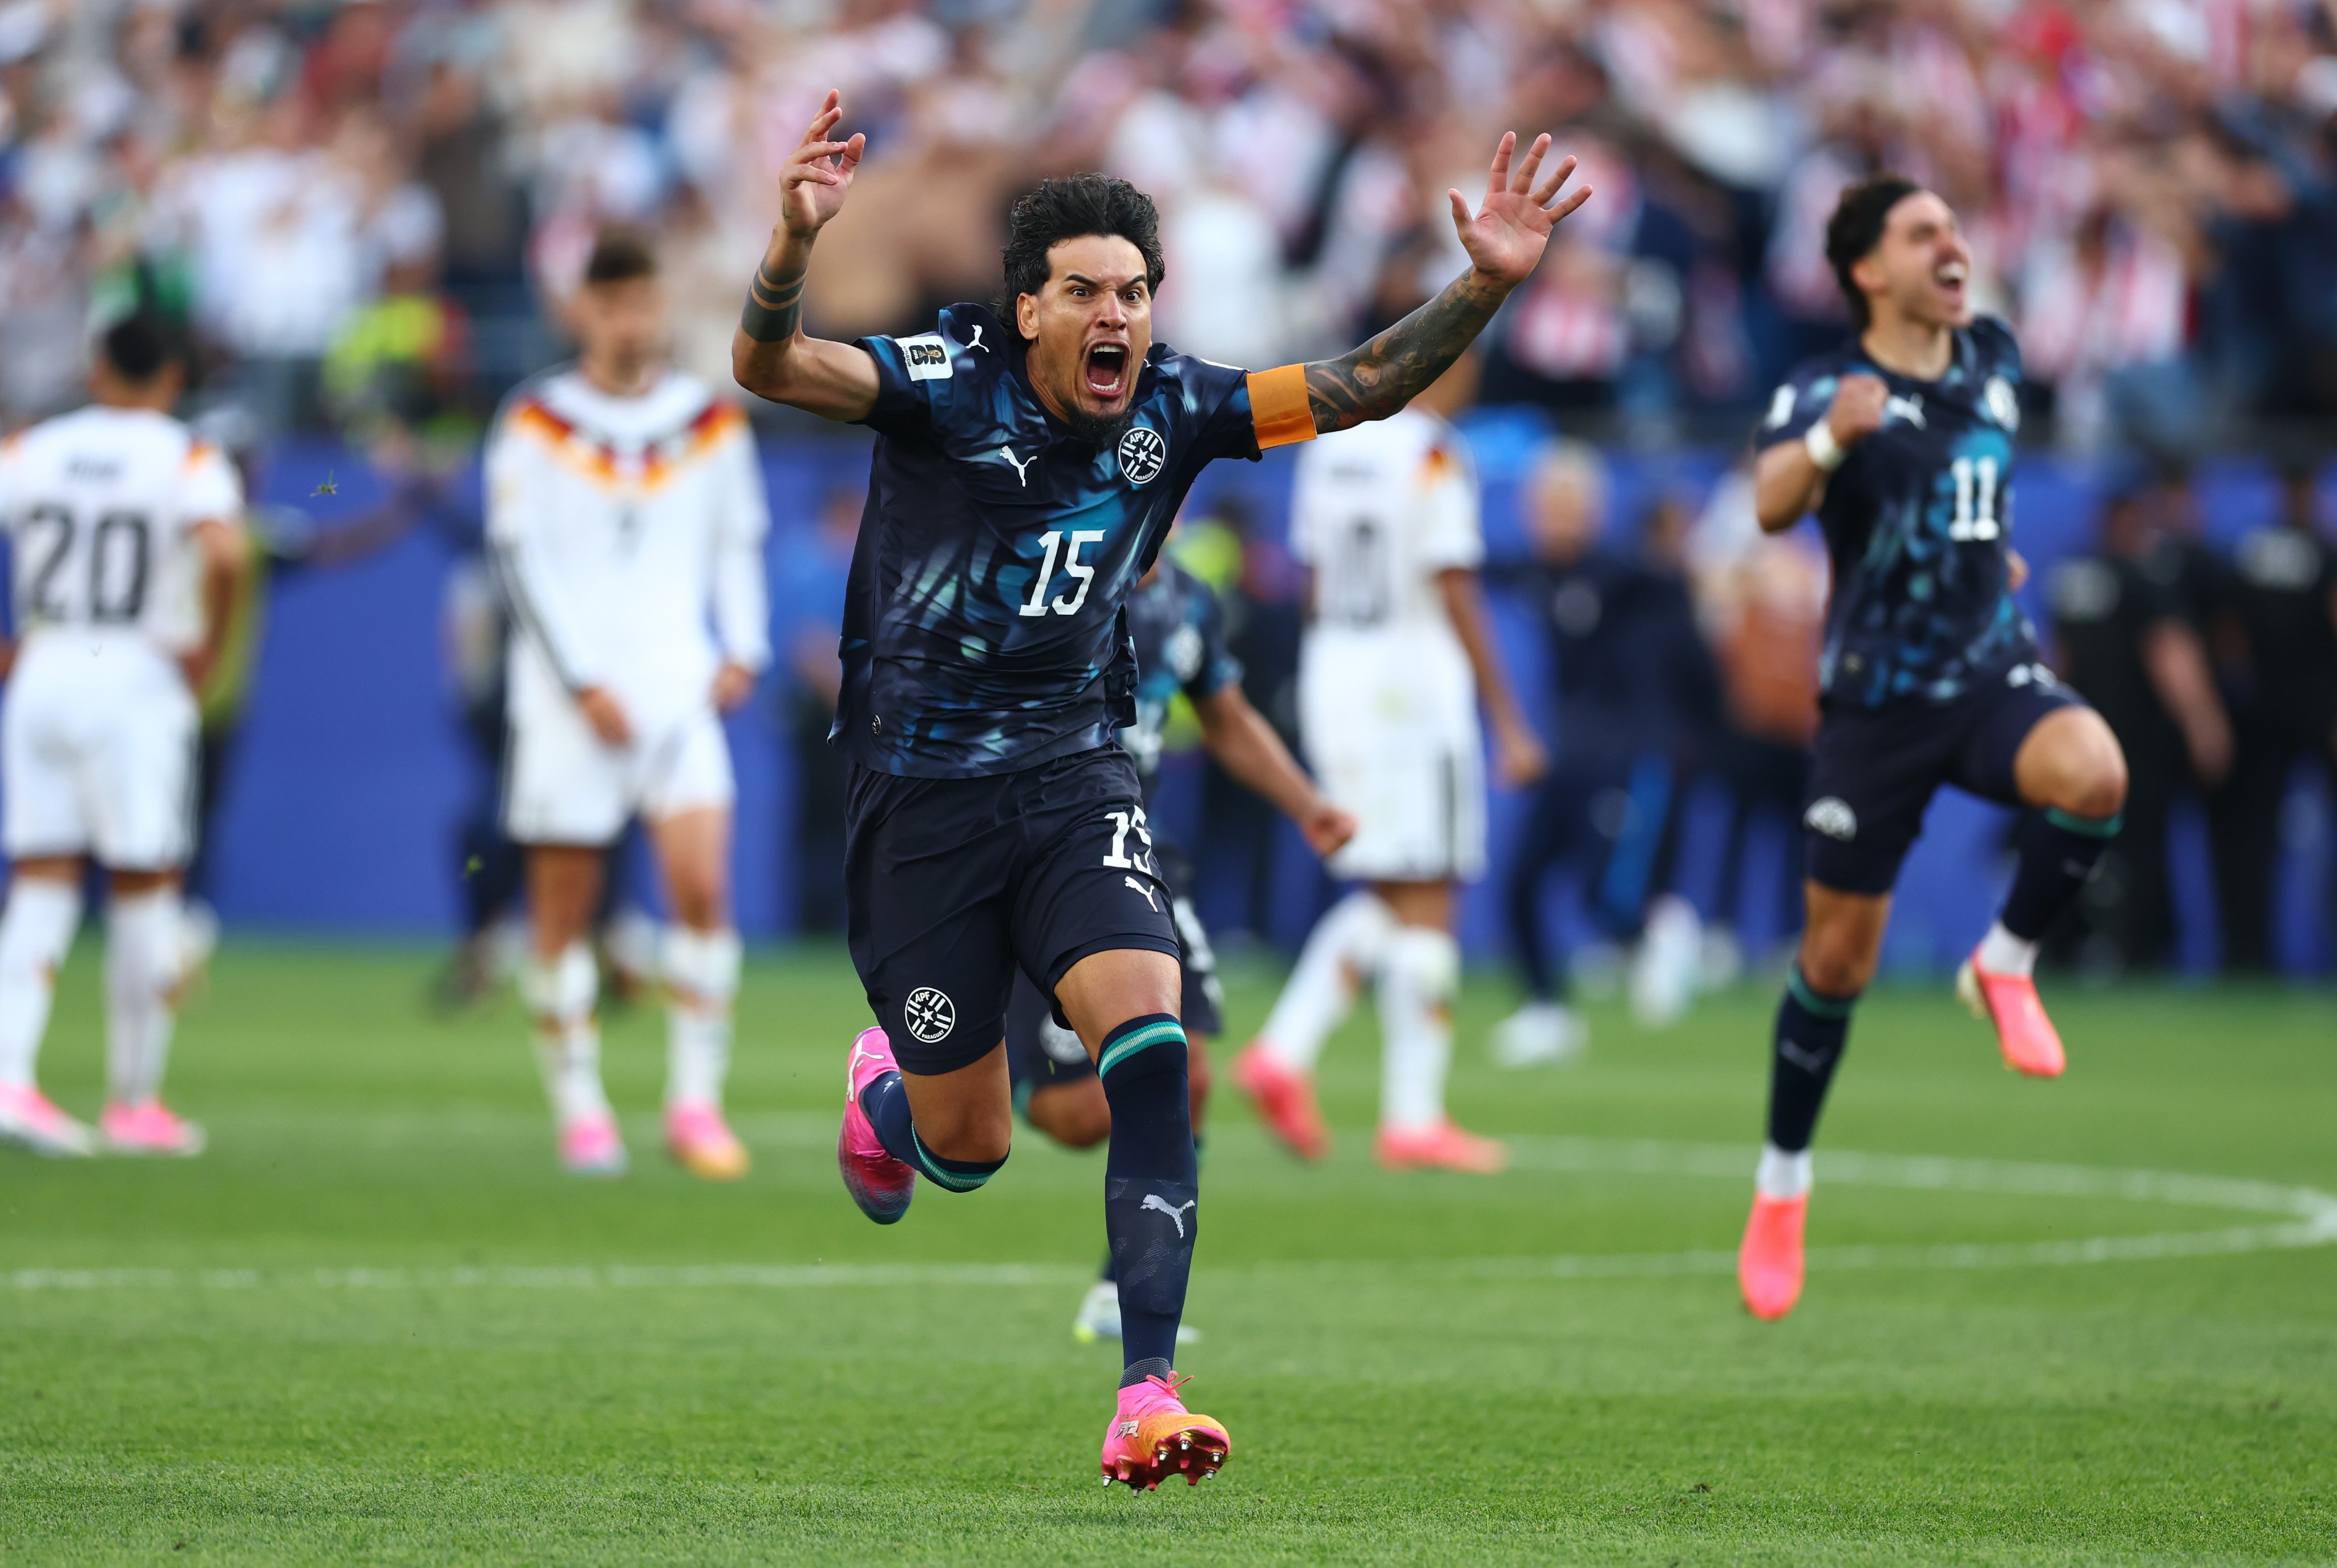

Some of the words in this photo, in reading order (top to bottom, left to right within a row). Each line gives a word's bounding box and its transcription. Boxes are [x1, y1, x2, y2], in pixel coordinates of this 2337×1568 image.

[1130, 431, 1145, 444] APF
[1135, 469, 1155, 480] PARAGUAY
[1948, 456, 2000, 541] 11
[30, 502, 149, 623] 20
[1019, 529, 1106, 617] 15
[1103, 805, 1152, 876] 15
[915, 991, 930, 1003] APF
[921, 1029, 944, 1039] PARAGUAY
